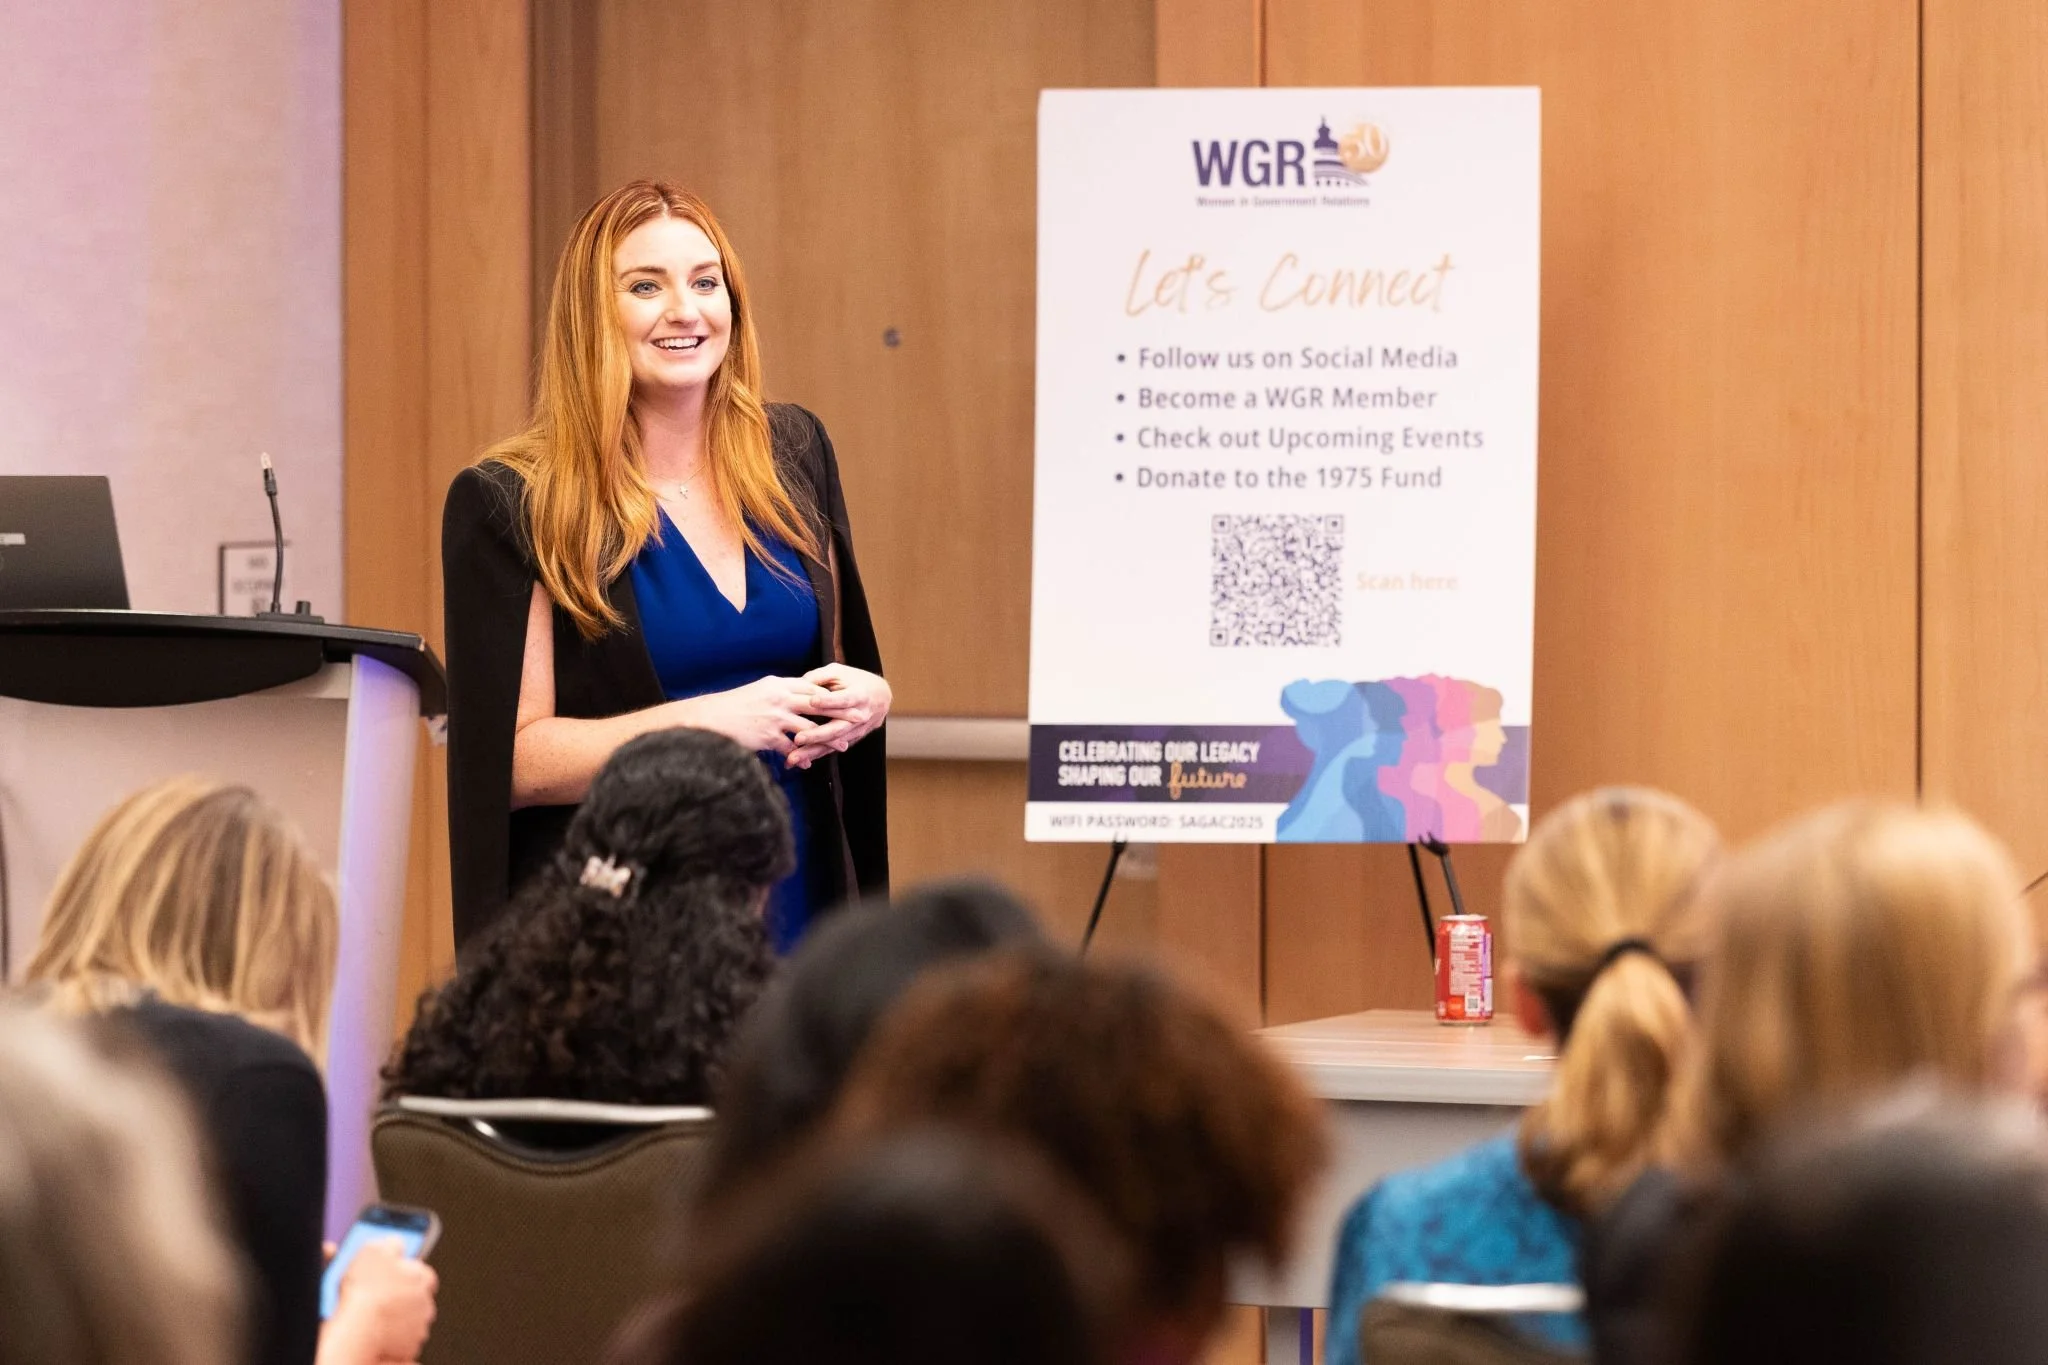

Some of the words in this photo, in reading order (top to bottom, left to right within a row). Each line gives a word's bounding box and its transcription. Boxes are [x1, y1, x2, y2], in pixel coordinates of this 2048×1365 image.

[1192, 140, 1305, 187] WGR
[1196, 197, 1235, 207] Women
[1240, 197, 1249, 207] in
[1254, 197, 1316, 207] Government
[1323, 197, 1370, 207] Relations
[1125, 248, 1238, 317] Let's
[1259, 252, 1455, 313] Connect
[1139, 347, 1219, 368] Follow
[1228, 352, 1254, 368] us
[1262, 352, 1292, 368] on
[1300, 347, 1373, 368] Social
[1381, 347, 1458, 368] Media
[1138, 388, 1236, 409] Become
[1244, 393, 1257, 409] a
[1265, 388, 1323, 409] WGR
[1332, 387, 1438, 409] Member
[1137, 426, 1211, 448] Check
[1219, 430, 1260, 448] out
[1269, 427, 1394, 454] Upcoming
[1402, 427, 1484, 449] Events
[1136, 467, 1226, 489] Donate
[1234, 470, 1259, 489] to
[1267, 467, 1307, 489] the
[1317, 467, 1372, 489] 1975
[1381, 467, 1442, 489] Fund
[1356, 572, 1403, 591] Scan
[1410, 571, 1459, 591] here
[1058, 740, 1162, 762] CELEBRATING
[1164, 741, 1198, 762] OUR
[1200, 741, 1260, 763] LEGACY
[1058, 764, 1126, 787] SHAPING
[1128, 765, 1162, 787] OUR
[1168, 760, 1247, 800] future
[1050, 815, 1083, 828] WIFI
[1086, 815, 1171, 828] PASSWORD:
[1180, 815, 1263, 828] SAGAC2025
